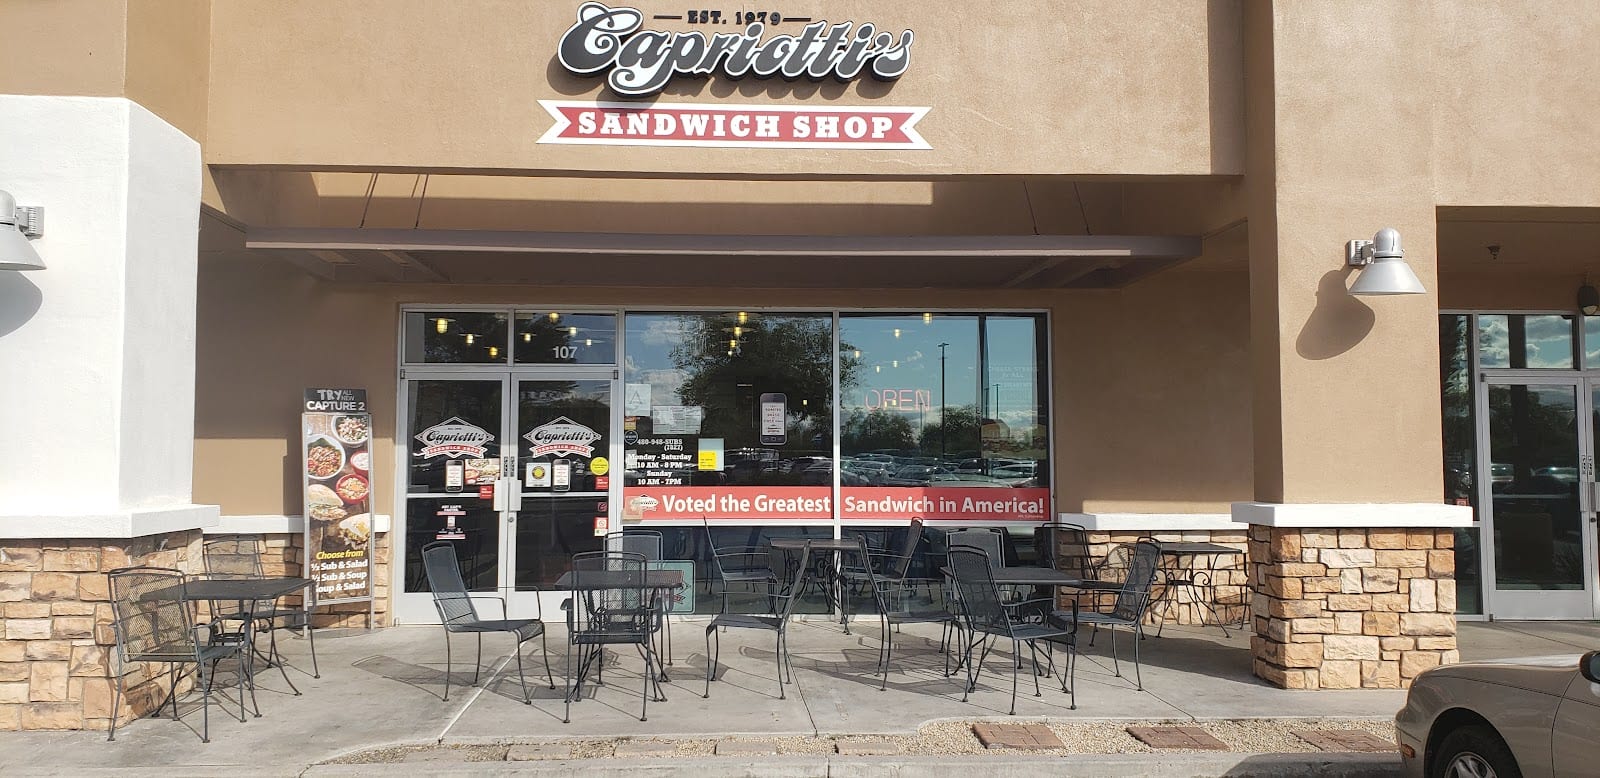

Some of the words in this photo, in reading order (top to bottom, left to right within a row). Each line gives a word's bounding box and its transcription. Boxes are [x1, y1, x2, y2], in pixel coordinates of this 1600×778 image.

[687, 10, 727, 24] EST.
[735, 11, 781, 26] 1979
[556, 1, 914, 97] Capriotti's
[578, 111, 780, 138] SANDWICH
[793, 115, 894, 139] SHOP
[552, 346, 578, 359] 107
[316, 389, 342, 401] TRY
[865, 389, 931, 412] OPEN
[306, 400, 357, 411] CAPTURE
[358, 401, 366, 411] 2
[662, 494, 716, 513] Voted
[720, 494, 750, 513] the
[754, 494, 831, 513] Greatest
[844, 496, 934, 513] Sandwich
[939, 496, 957, 513] in
[961, 496, 1044, 514] America!
[316, 551, 344, 560] Choose
[345, 549, 364, 558] from
[321, 561, 337, 570] Sub
[338, 561, 345, 569] &
[346, 559, 369, 569] Salad
[321, 573, 337, 582] Sub
[339, 572, 346, 580] &
[346, 571, 368, 580] Soup
[336, 583, 342, 591] &
[343, 581, 366, 591] Salad
